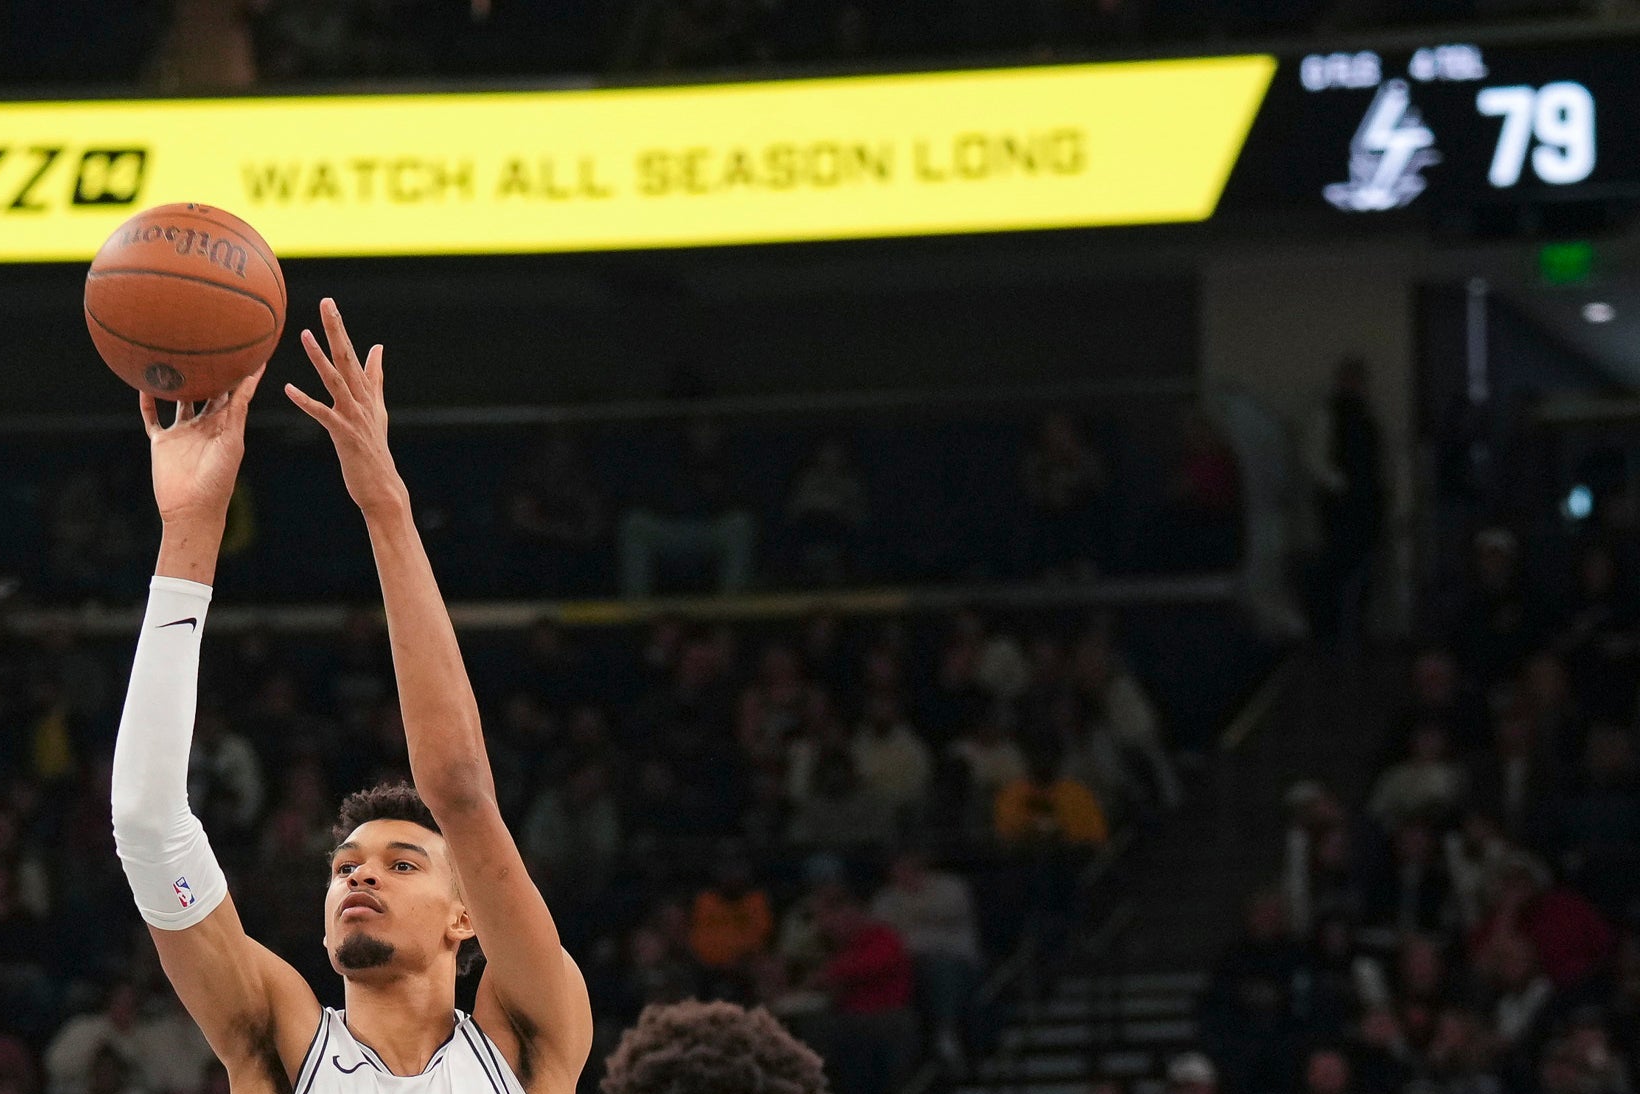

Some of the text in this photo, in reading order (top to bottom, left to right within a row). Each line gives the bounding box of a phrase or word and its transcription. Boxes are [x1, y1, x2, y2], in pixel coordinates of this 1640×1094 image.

[242, 128, 1088, 204] WATCH ALL SEASON LONG
[1476, 81, 1597, 188] 79
